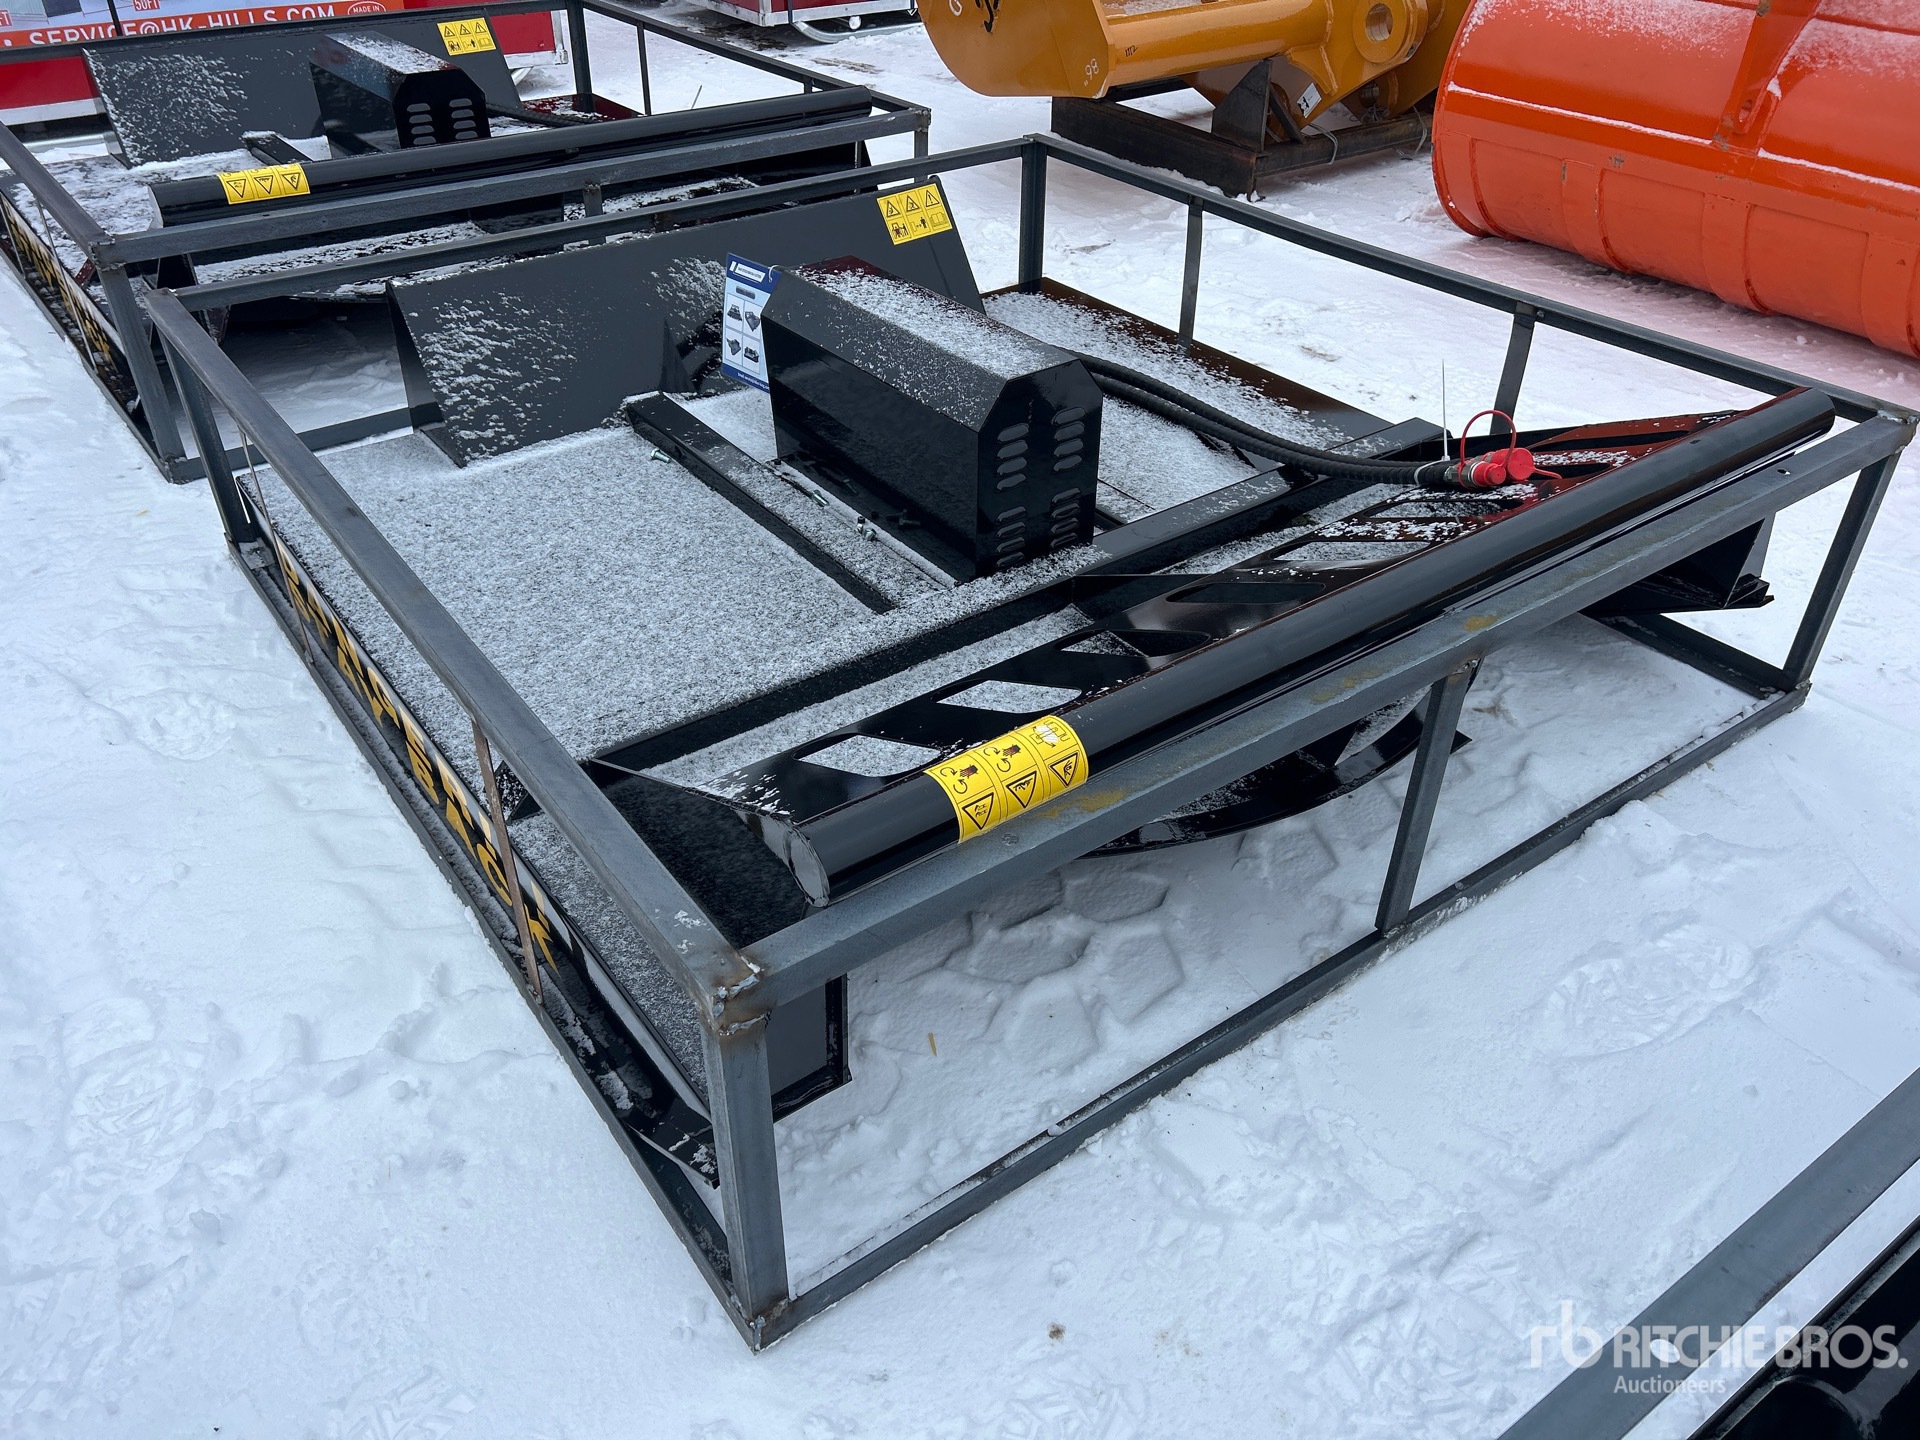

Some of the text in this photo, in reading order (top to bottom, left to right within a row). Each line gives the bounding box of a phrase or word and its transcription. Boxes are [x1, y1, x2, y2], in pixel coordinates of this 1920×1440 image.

[29, 5, 335, 45] SERVIE@HK-HILLSCOM
[134, 0, 159, 10] 50FT
[286, 576, 383, 728] STAY
[275, 538, 549, 931] DANGER!!
[406, 740, 561, 978] BACK
